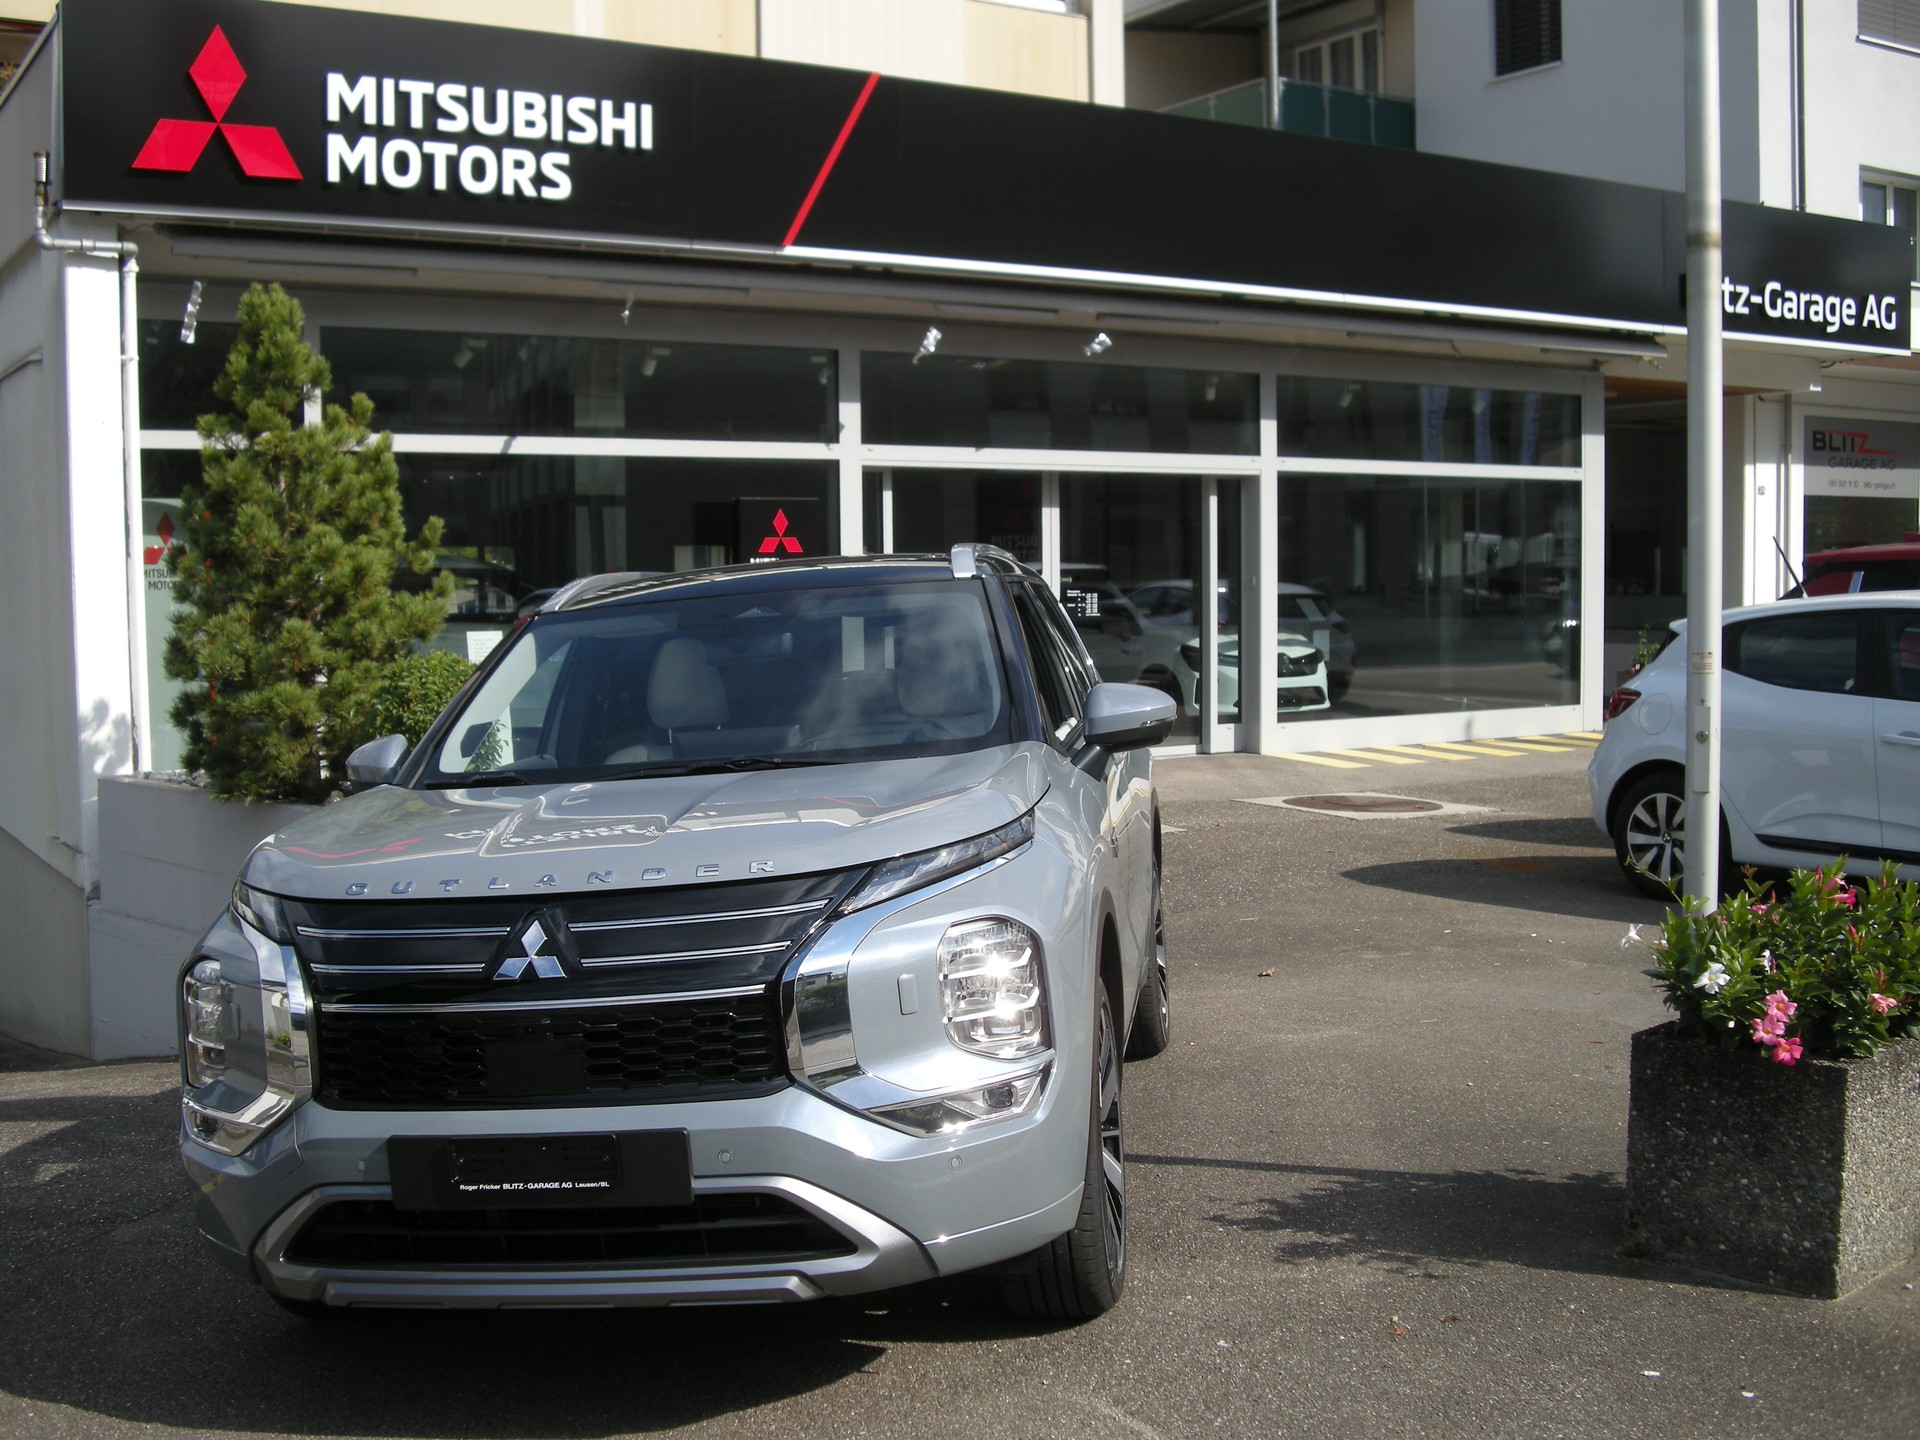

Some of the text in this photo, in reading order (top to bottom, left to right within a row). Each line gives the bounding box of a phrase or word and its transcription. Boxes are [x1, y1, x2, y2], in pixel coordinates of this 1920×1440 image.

[326, 72, 653, 150] MITSUBISHI
[326, 134, 572, 200] MOTORS
[1862, 294, 1897, 330] AG
[1828, 457, 1896, 471] GARAGE AG
[345, 859, 776, 896] OUTLANDER
[502, 1182, 560, 1190] BLITZ-GARAGE
